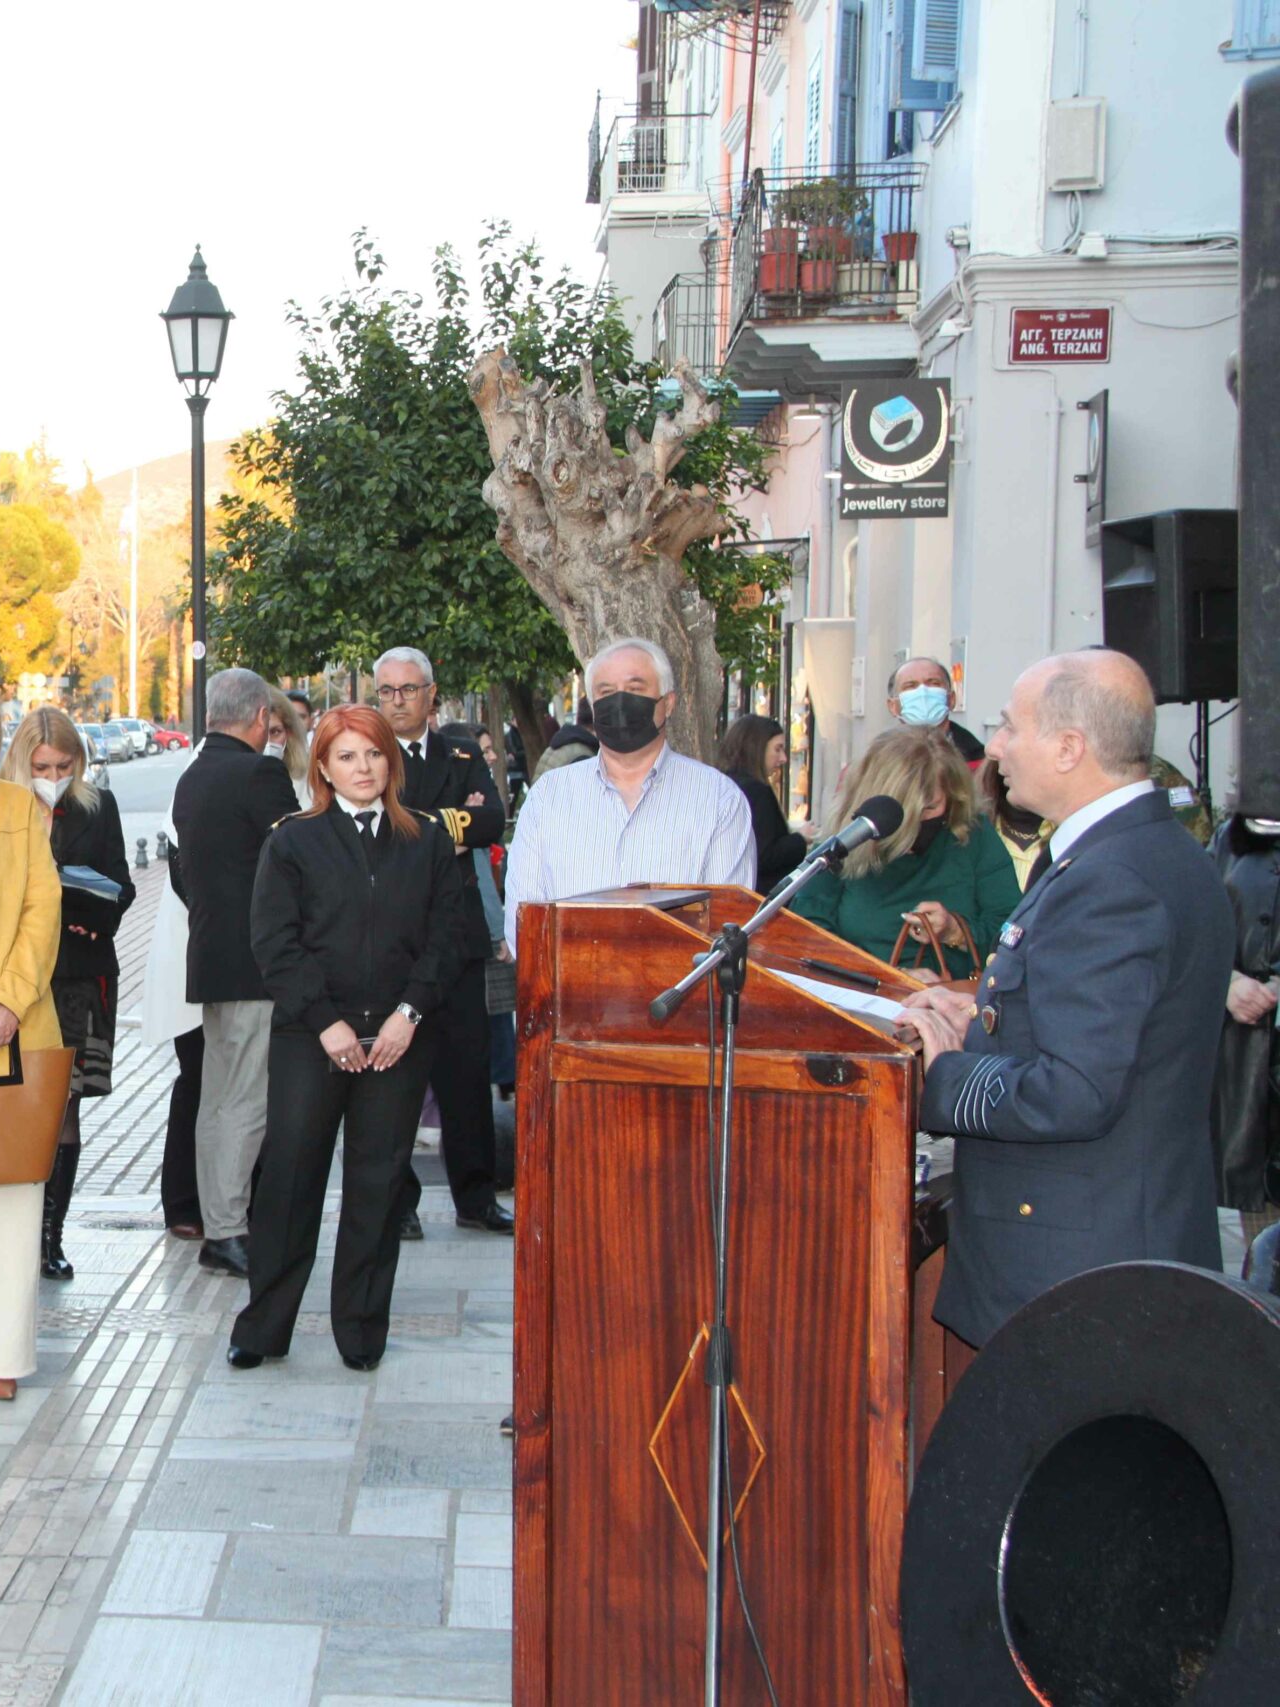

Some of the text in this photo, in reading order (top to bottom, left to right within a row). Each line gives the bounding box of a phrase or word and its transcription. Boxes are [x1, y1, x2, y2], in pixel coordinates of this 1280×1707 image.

[1050, 328, 1103, 340] ΤΕΡΖΑΚΗ
[1020, 342, 1102, 354] ANG. TERZAKI
[842, 496, 946, 513] Jewellery store
